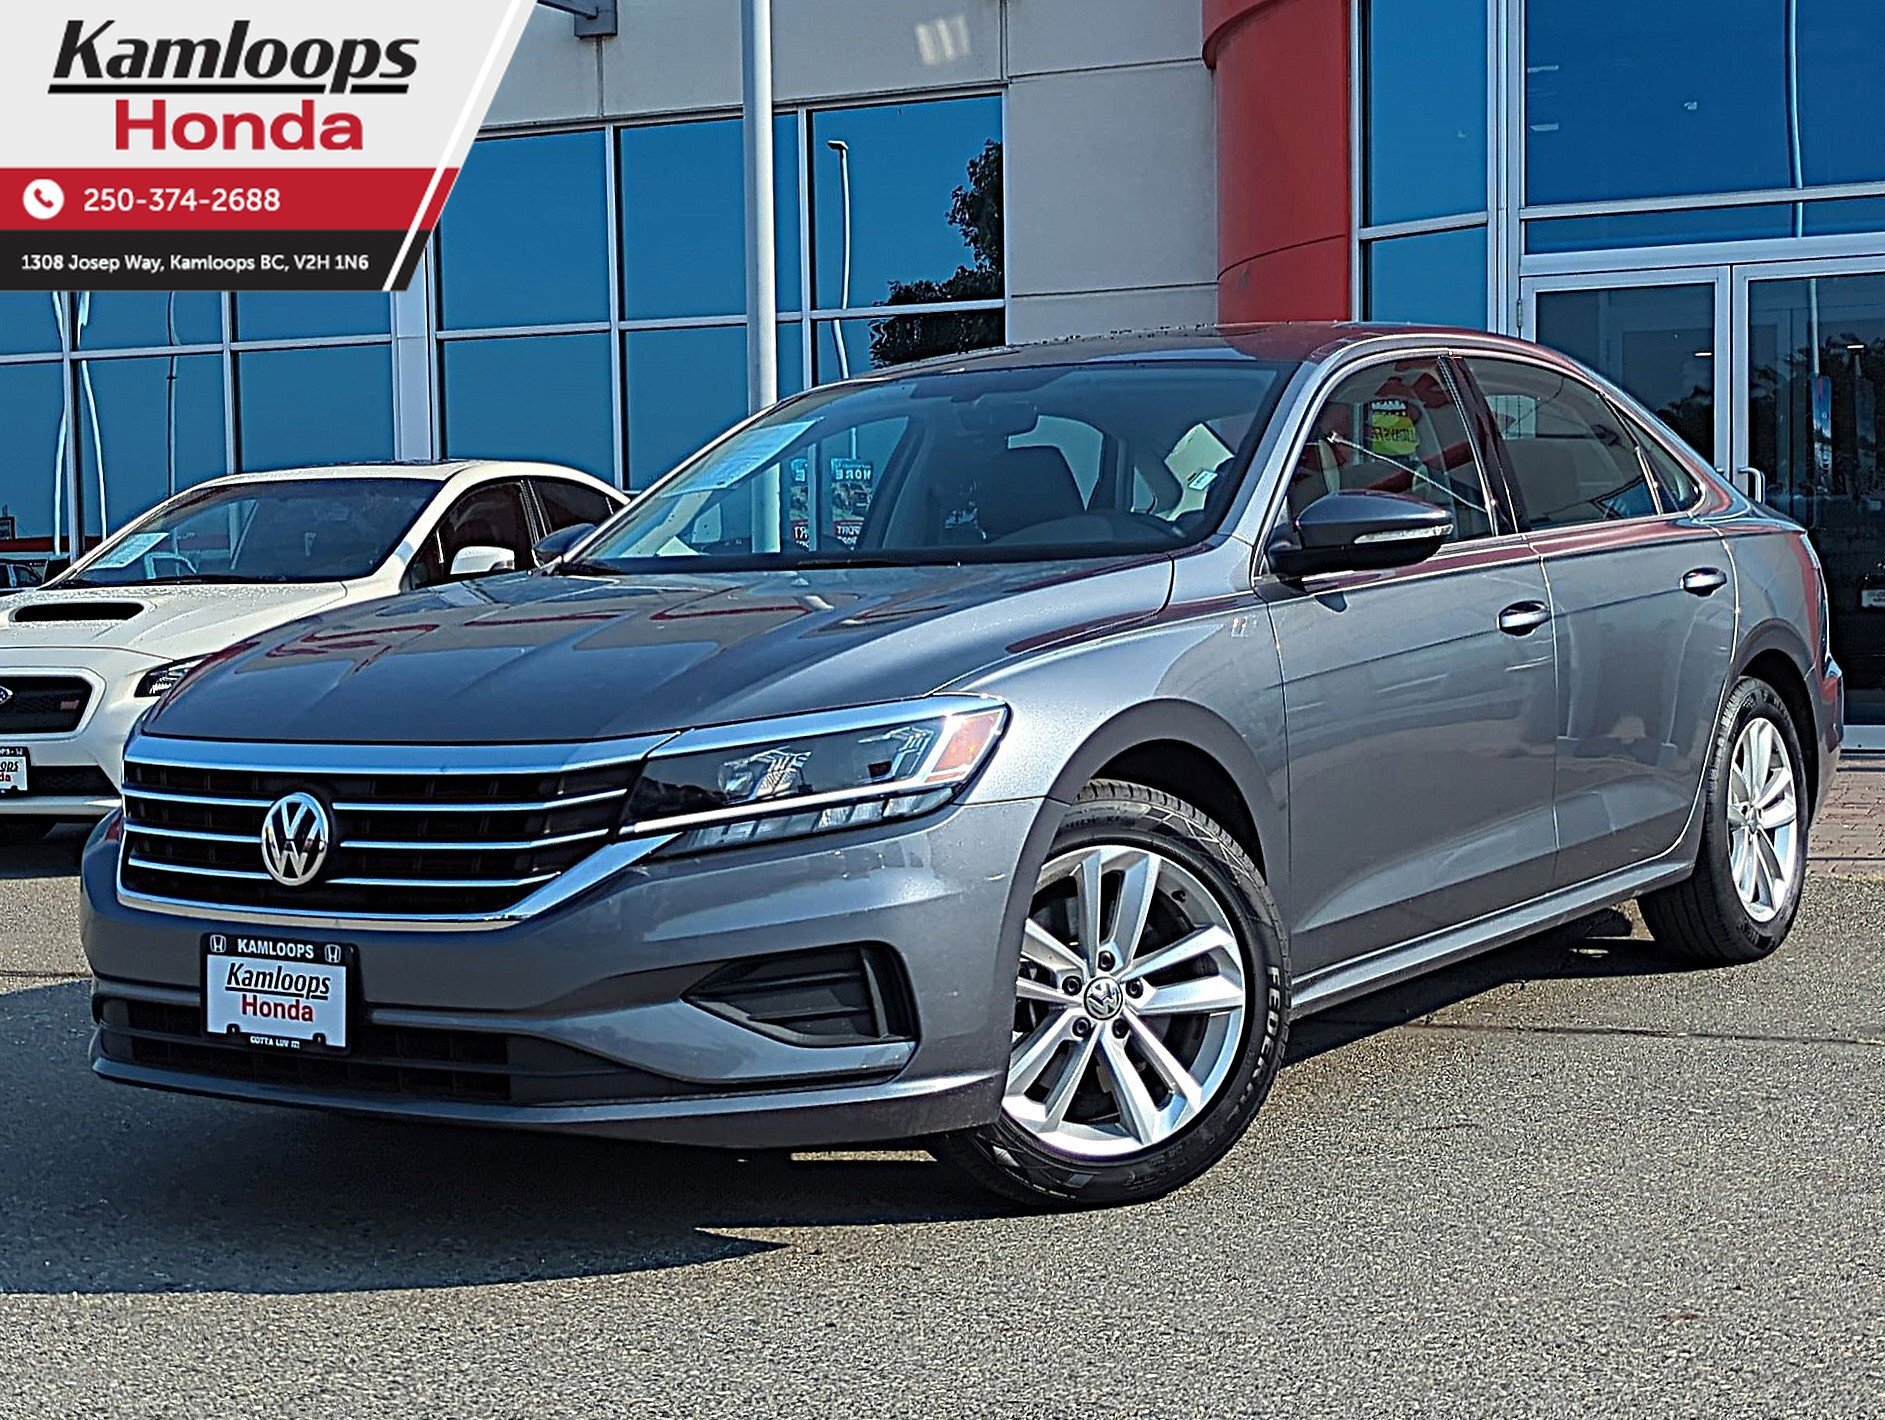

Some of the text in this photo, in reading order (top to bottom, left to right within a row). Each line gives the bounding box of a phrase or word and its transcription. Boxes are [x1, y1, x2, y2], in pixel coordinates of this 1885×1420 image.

[237, 938, 315, 959] KAMLOOPS
[226, 962, 331, 1000] Kamloops
[241, 993, 314, 1022] Honda
